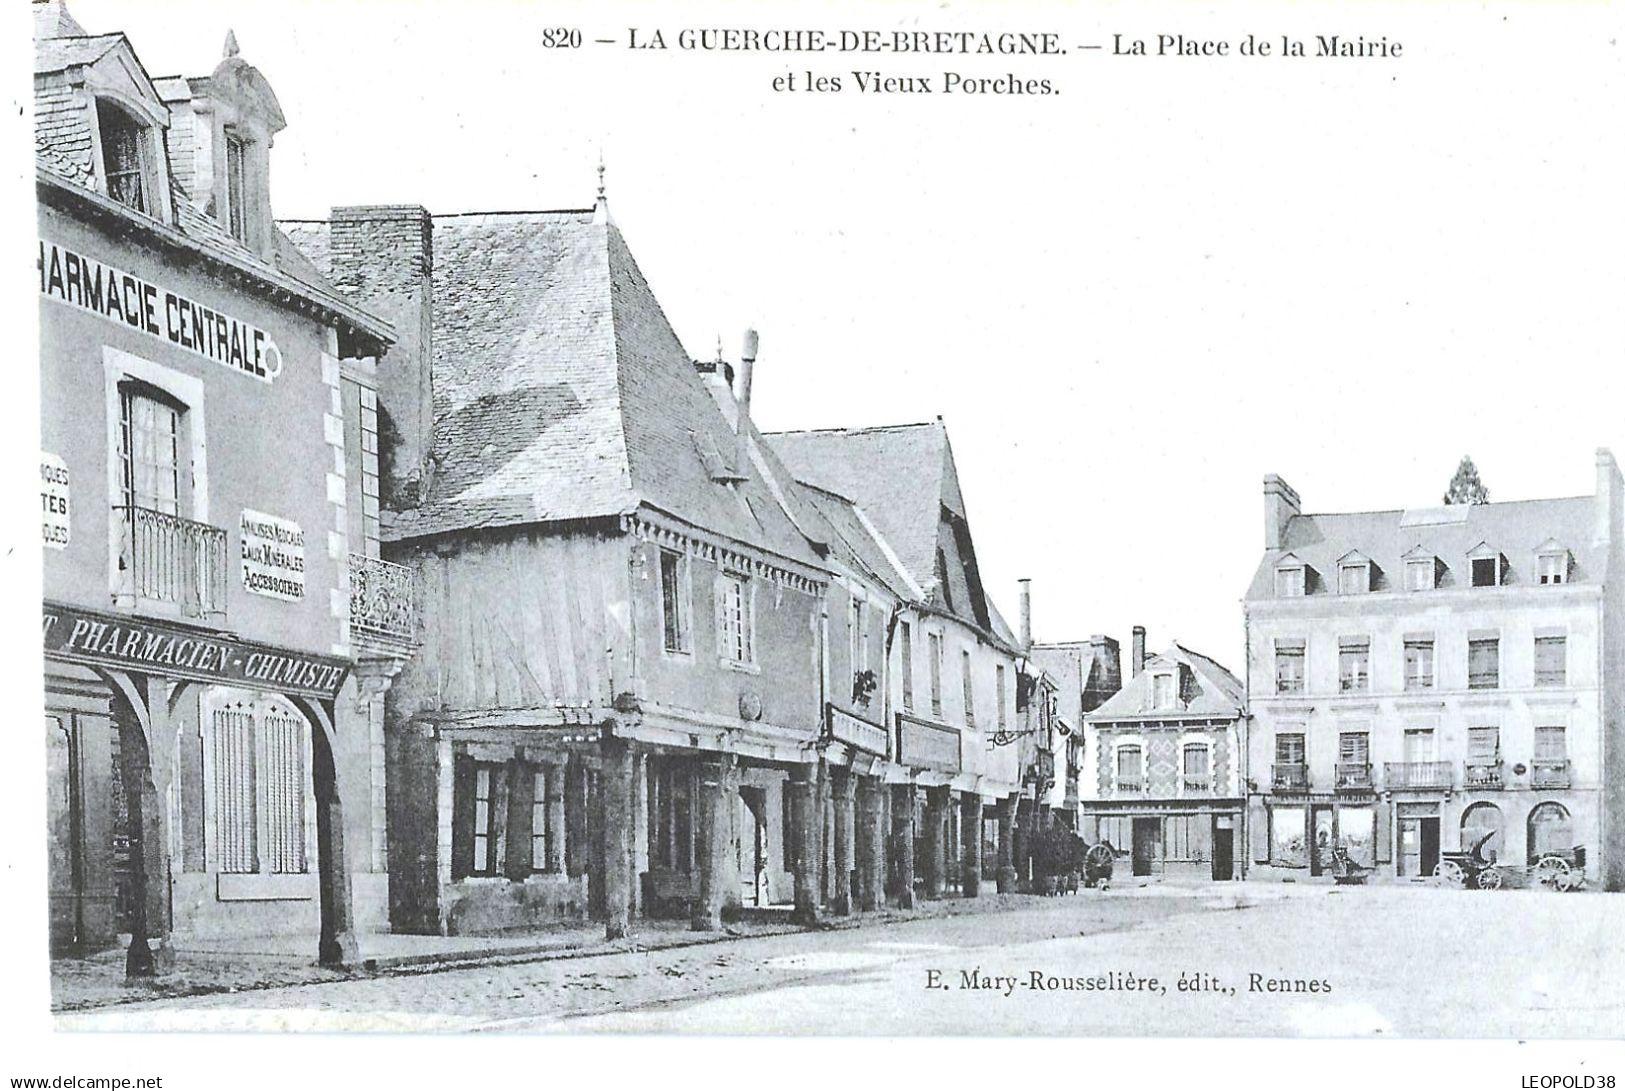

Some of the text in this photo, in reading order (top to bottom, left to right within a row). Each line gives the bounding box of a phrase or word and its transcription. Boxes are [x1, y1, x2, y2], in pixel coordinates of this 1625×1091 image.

[166, 293, 266, 378] CENTRALE
[243, 565, 304, 597] ACCESSOIRES
[66, 619, 232, 672] PHARMACIEN
[245, 652, 343, 690] CHIMISTE
